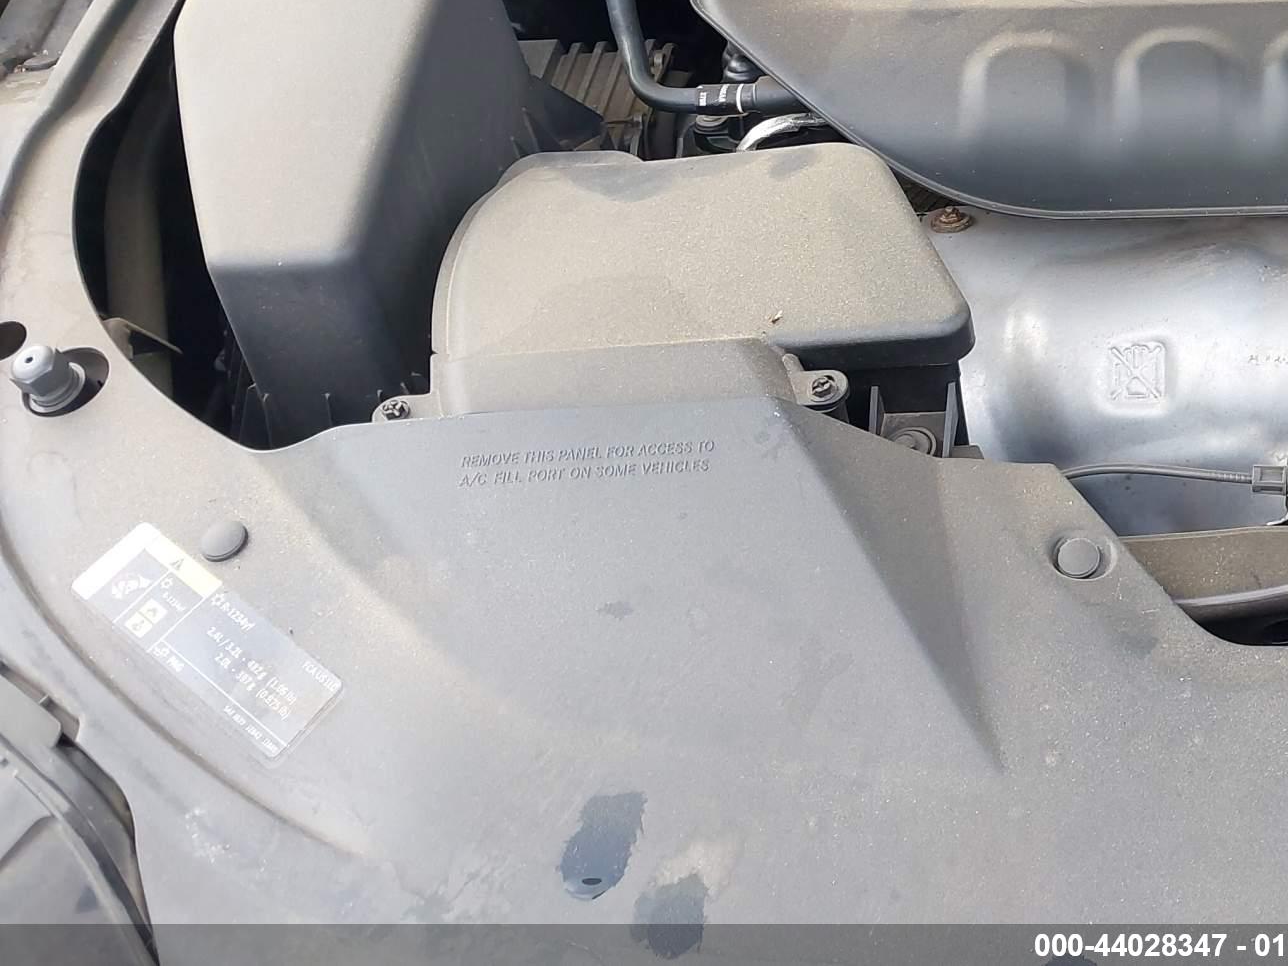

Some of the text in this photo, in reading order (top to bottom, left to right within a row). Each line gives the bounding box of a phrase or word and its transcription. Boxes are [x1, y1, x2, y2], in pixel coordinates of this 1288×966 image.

[461, 438, 715, 468] REMOVE THIS PANEL FOR ACCESS TO
[460, 455, 710, 488] A/C FILL PORT ON SOME VEHICLES
